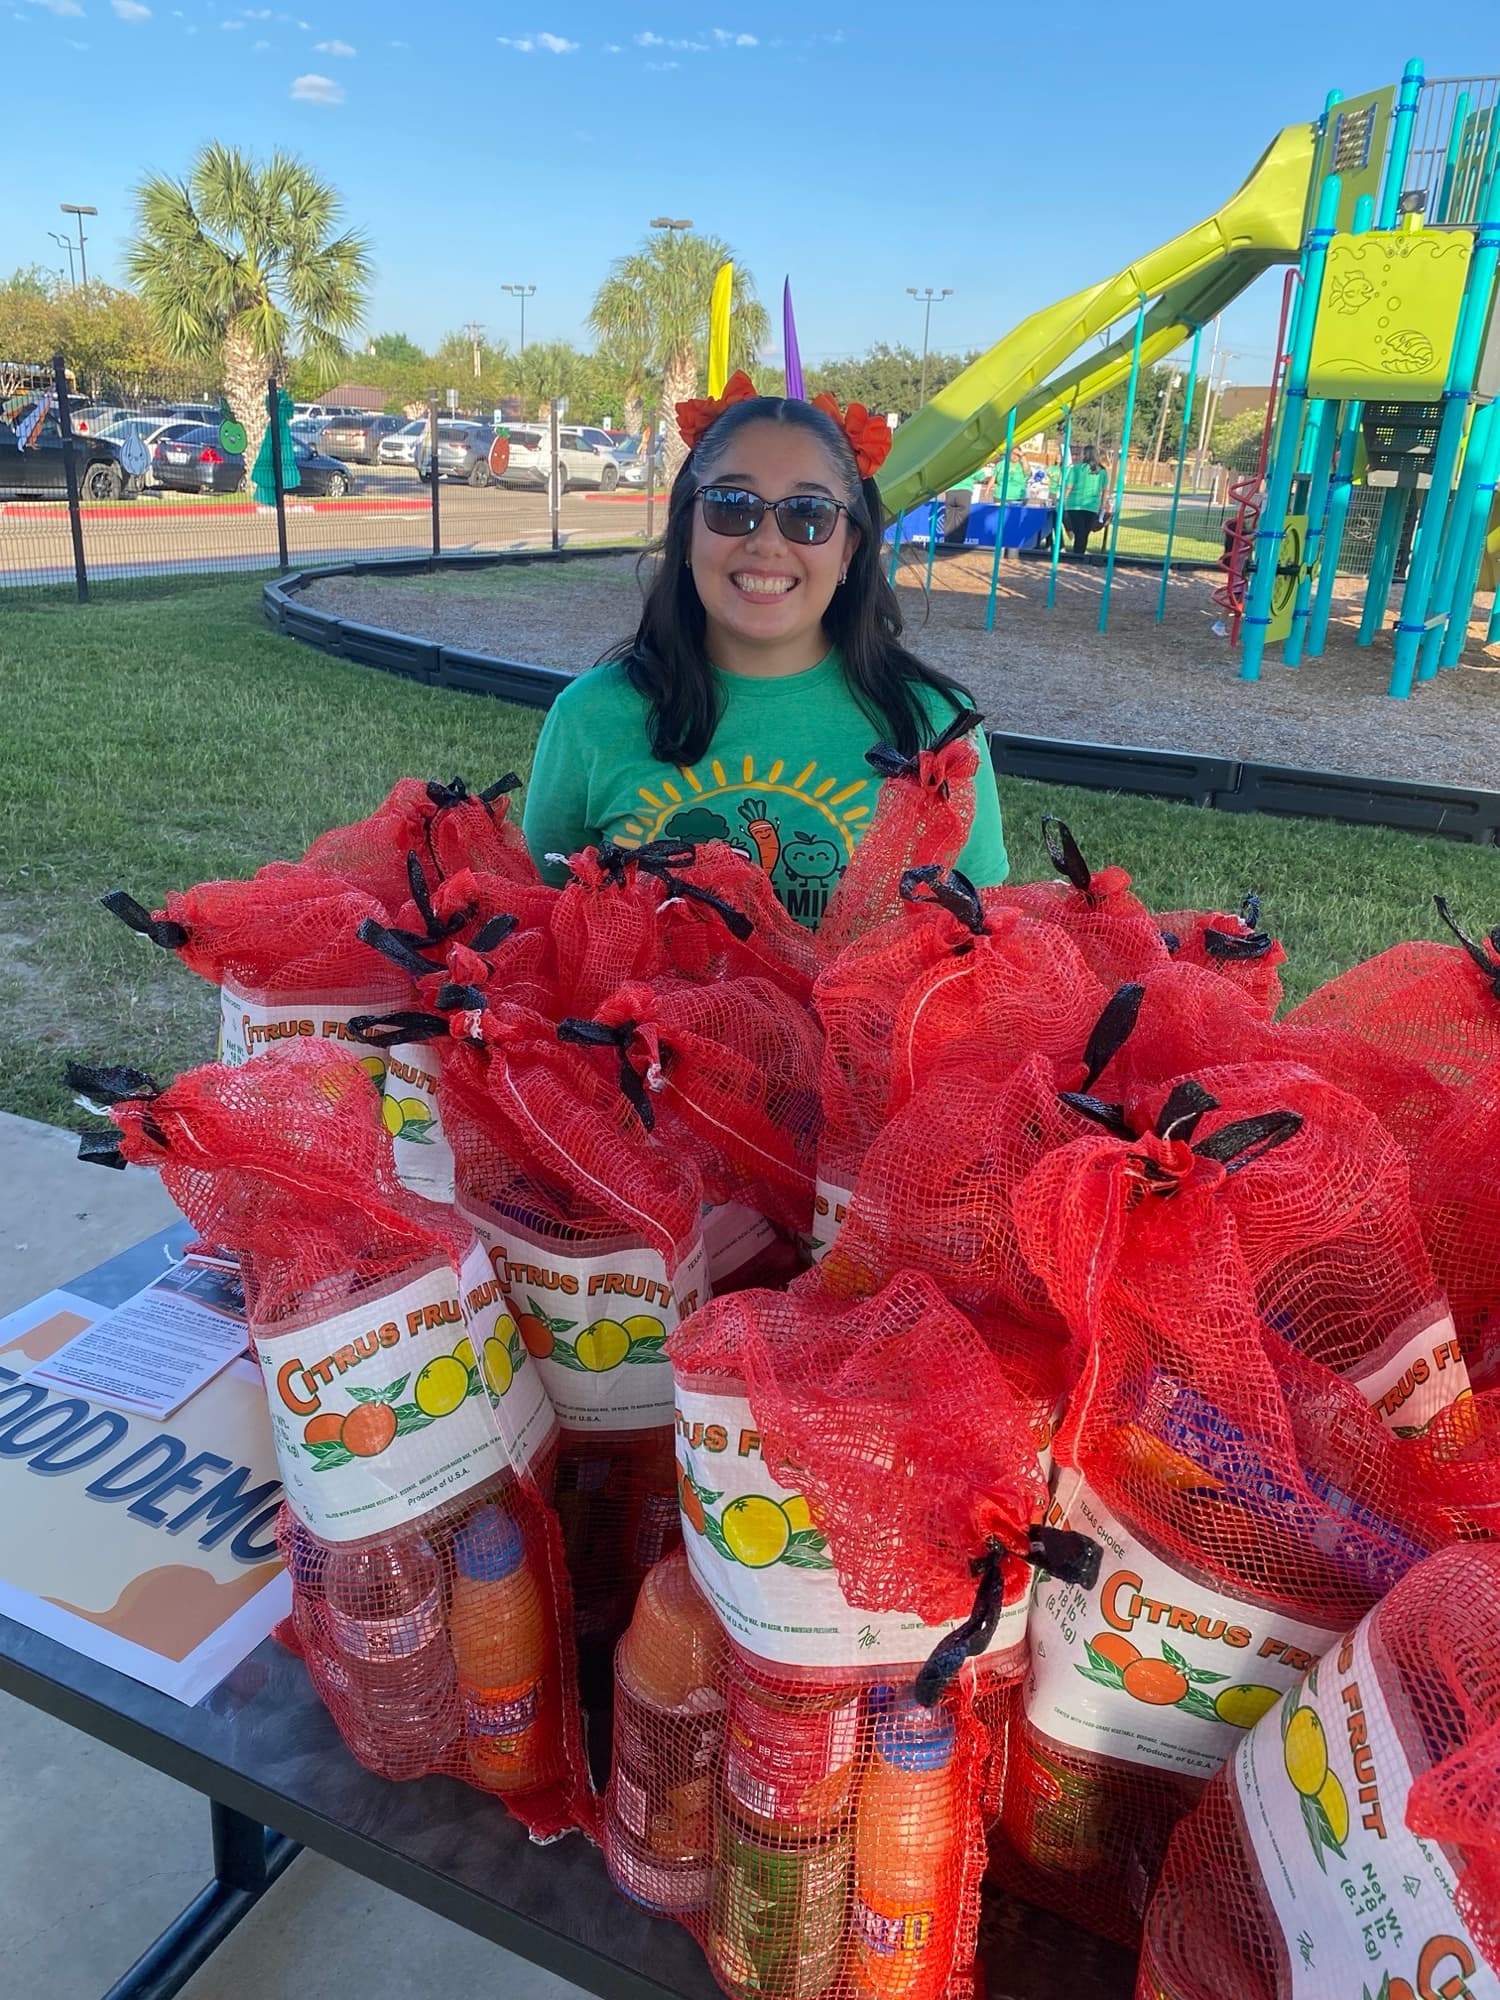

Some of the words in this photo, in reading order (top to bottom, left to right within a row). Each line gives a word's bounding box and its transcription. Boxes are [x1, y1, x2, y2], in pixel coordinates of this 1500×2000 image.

[489, 1246, 579, 1296] CITRUS
[587, 1273, 673, 1309] FRUIT
[277, 1321, 400, 1416] CITRUS
[406, 1299, 464, 1338] FRU
[407, 1485, 438, 1506] Produce
[439, 1478, 447, 1488] of
[447, 1468, 471, 1483] U.S.A.
[1079, 1500, 1098, 1529] TEXAS
[1096, 1525, 1126, 1559] CHOICE
[1046, 1594, 1060, 1620] (8.1
[1060, 1617, 1077, 1645] kg)
[1058, 1590, 1069, 1607] 18
[1074, 1589, 1088, 1617] Wt.
[1100, 1569, 1252, 1648] CITRUS
[1136, 1744, 1174, 1760] Produce
[1175, 1755, 1185, 1763] of
[1341, 1681, 1388, 1840] FRUIT
[1340, 1878, 1366, 1917] (8.1
[1361, 1924, 1382, 1961] kg)
[1360, 1886, 1377, 1912] 18
[1374, 1917, 1387, 1940] lb
[1361, 1862, 1387, 1905] Net
[1385, 1907, 1404, 1949] Wt.
